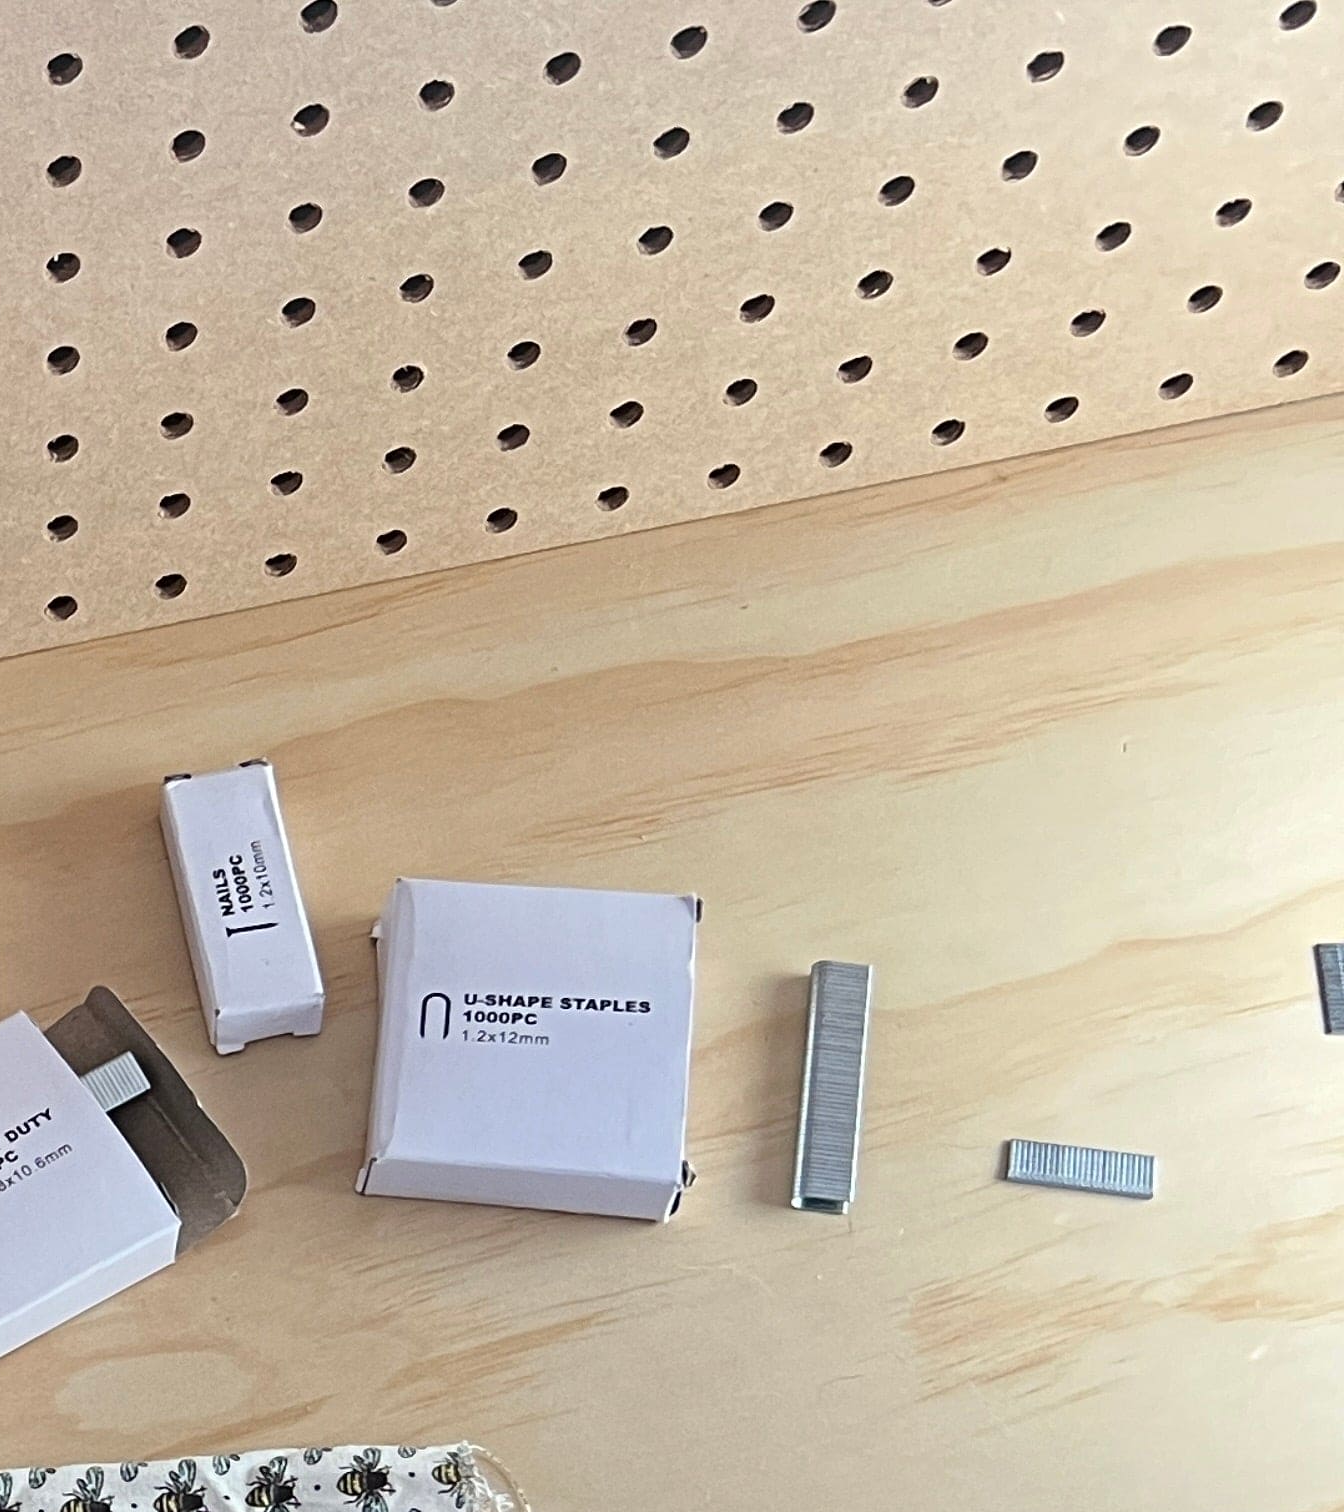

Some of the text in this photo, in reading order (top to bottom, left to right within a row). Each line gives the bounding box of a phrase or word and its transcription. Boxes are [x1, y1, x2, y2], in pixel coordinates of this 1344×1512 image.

[212, 868, 236, 917] NAILS
[229, 854, 254, 913] 1000PC
[462, 1009, 539, 1026] 1000PC
[464, 993, 652, 1014] U-SHAPE STAPLES
[462, 1029, 550, 1046] 1.2x12mm
[4, 1107, 52, 1143] DUTY
